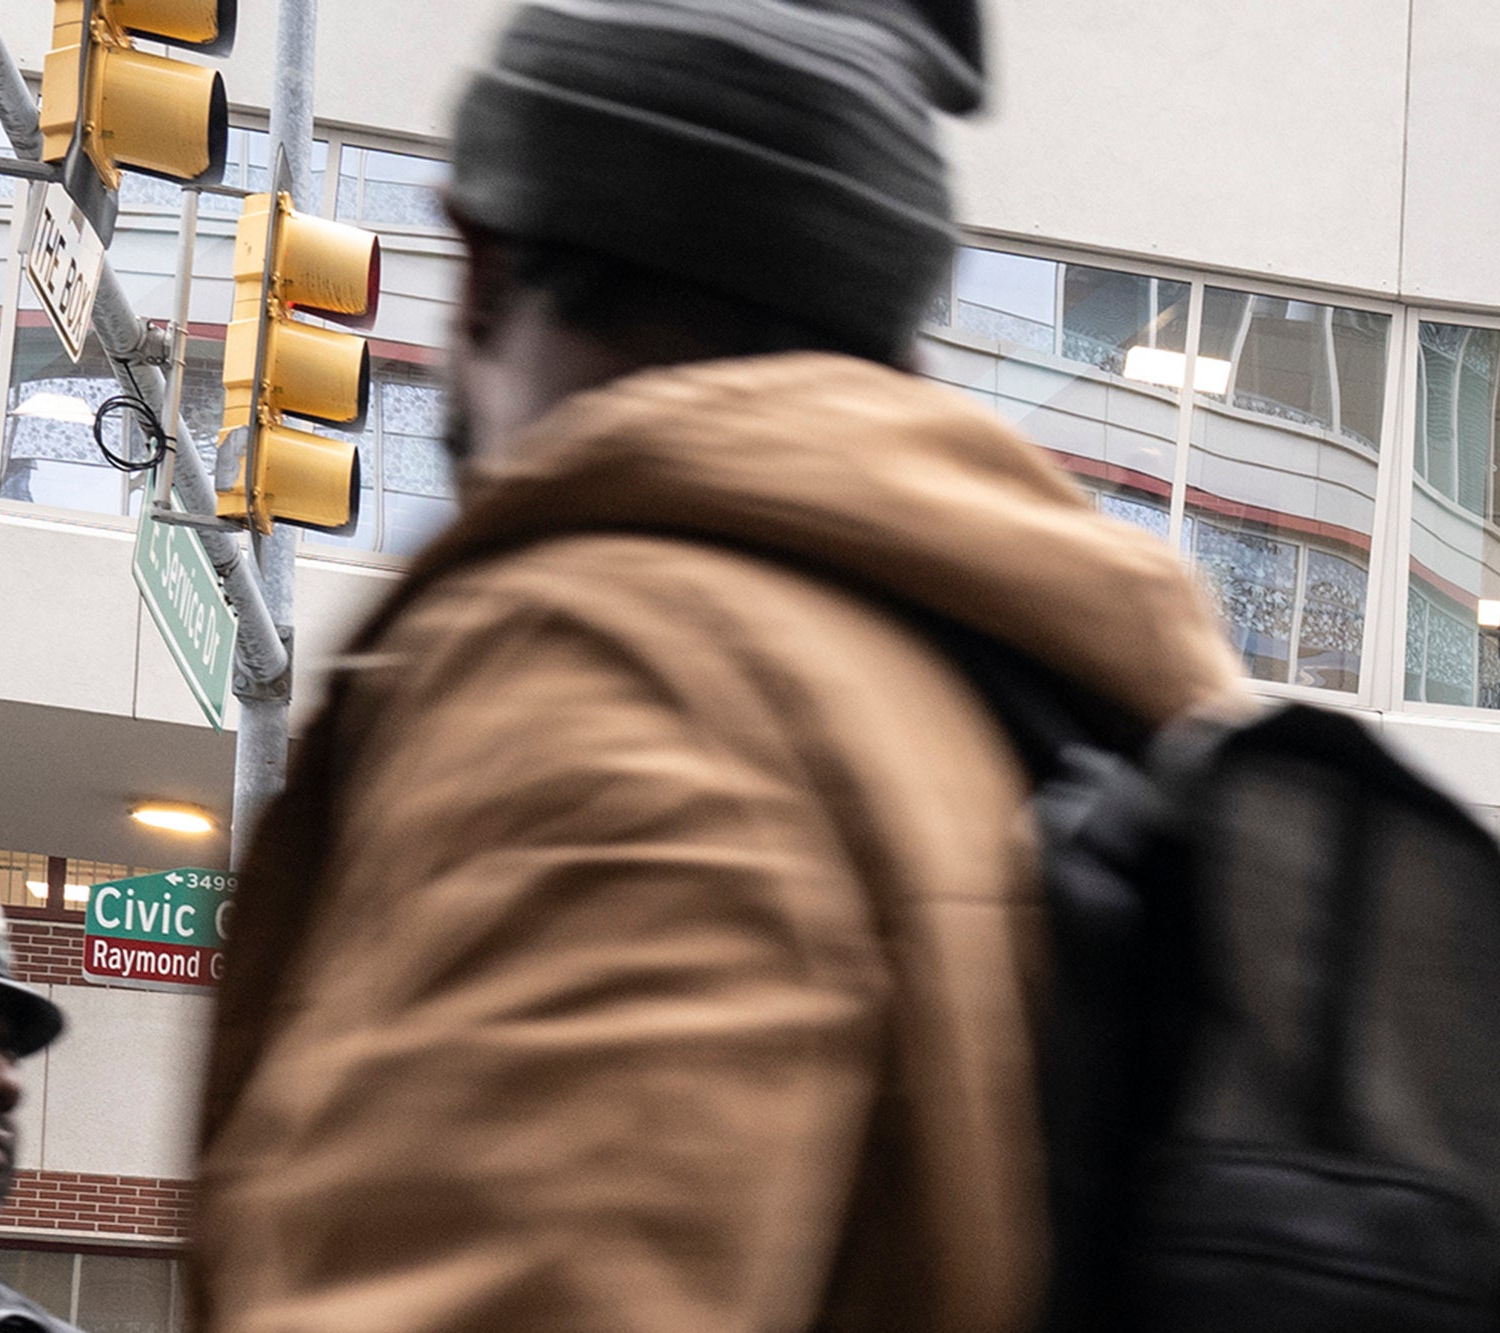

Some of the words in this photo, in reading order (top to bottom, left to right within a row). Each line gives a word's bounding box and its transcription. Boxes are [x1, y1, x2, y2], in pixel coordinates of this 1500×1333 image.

[34, 206, 67, 295] THE
[59, 257, 92, 343] BOX
[161, 526, 206, 650] Service
[202, 605, 221, 675] Dr
[186, 873, 238, 893] 3499
[94, 886, 196, 938] Civic
[93, 940, 200, 977] Raymond
